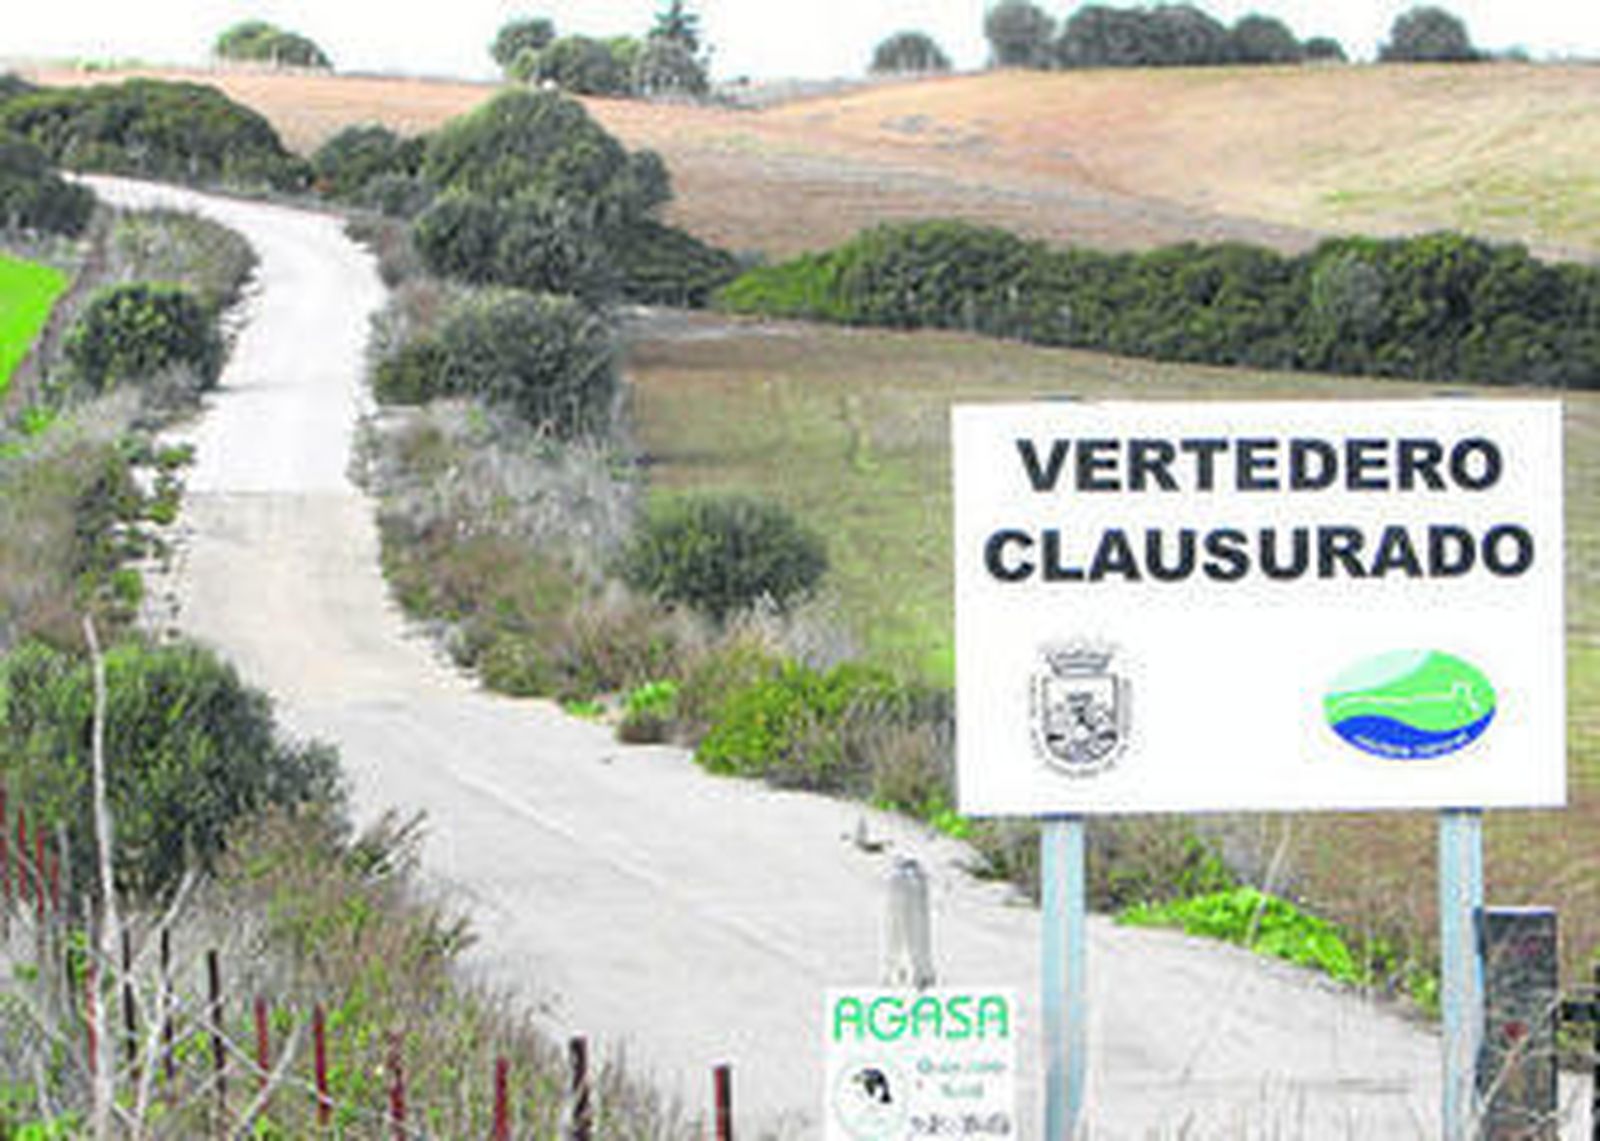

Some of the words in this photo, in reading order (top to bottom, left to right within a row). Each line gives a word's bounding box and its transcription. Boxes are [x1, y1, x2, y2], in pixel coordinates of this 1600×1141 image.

[1016, 438, 1502, 492] VERTEDERO
[984, 524, 1534, 583] CLAUSURADO
[832, 995, 1009, 1042] AGASA
